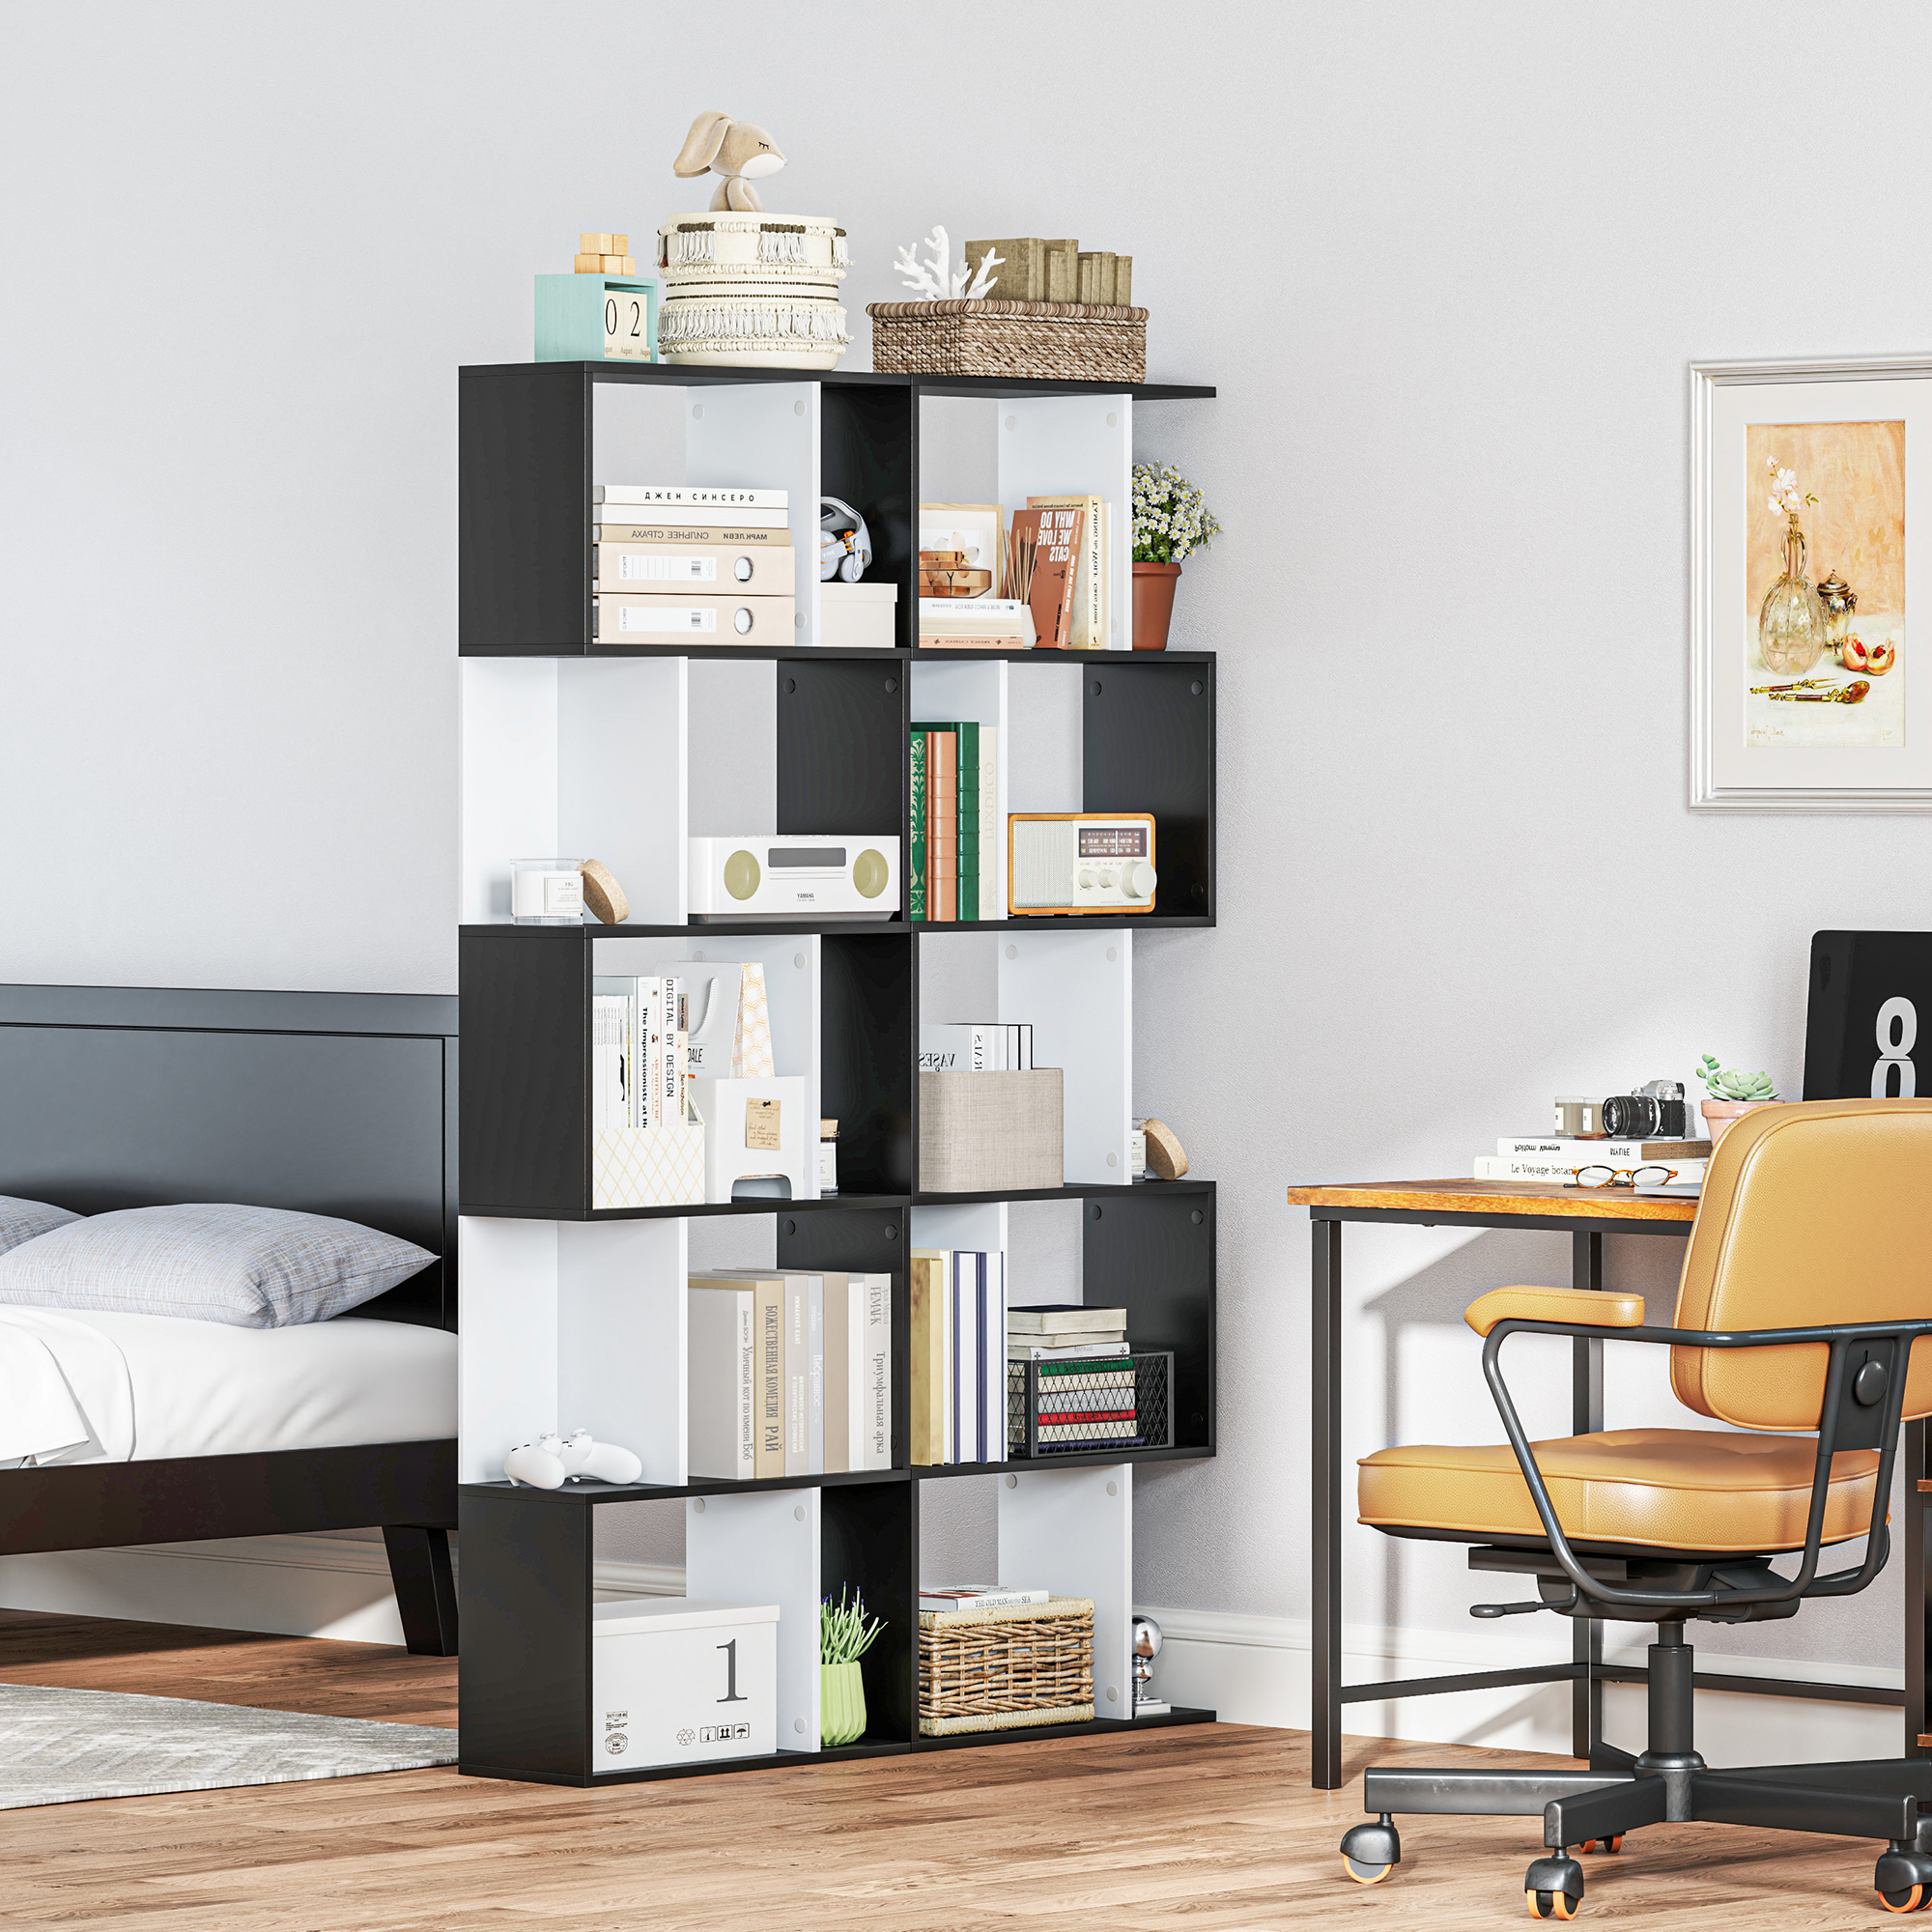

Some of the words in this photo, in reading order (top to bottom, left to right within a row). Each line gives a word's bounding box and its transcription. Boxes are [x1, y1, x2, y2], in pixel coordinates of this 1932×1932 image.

[644, 492, 681, 500] ДЖЕН
[693, 493, 755, 502] СИНСЕРО
[984, 762, 995, 839] LUXDECO
[666, 980, 674, 1026] DIGITAL
[667, 1034, 674, 1046] BY
[1870, 996, 1918, 1098] 8
[642, 1105, 647, 1114] at
[1511, 1164, 1520, 1173] Le
[1521, 1164, 1548, 1176] Voyage
[1551, 1165, 1573, 1175] botan
[870, 1287, 881, 1325] РЕМАРК
[765, 1305, 779, 1374] БОЖЕСТВЕННАЯ
[742, 1347, 753, 1383] Уличный
[810, 1354, 823, 1406] Избранное
[765, 1376, 779, 1419] КОМЕДИЯ
[873, 1352, 886, 1427] Триумфальная
[743, 1404, 750, 1413] по
[743, 1443, 753, 1460] Боб
[765, 1426, 782, 1452] РАЙ
[873, 1431, 884, 1454] арка
[717, 1638, 748, 1702] 1
